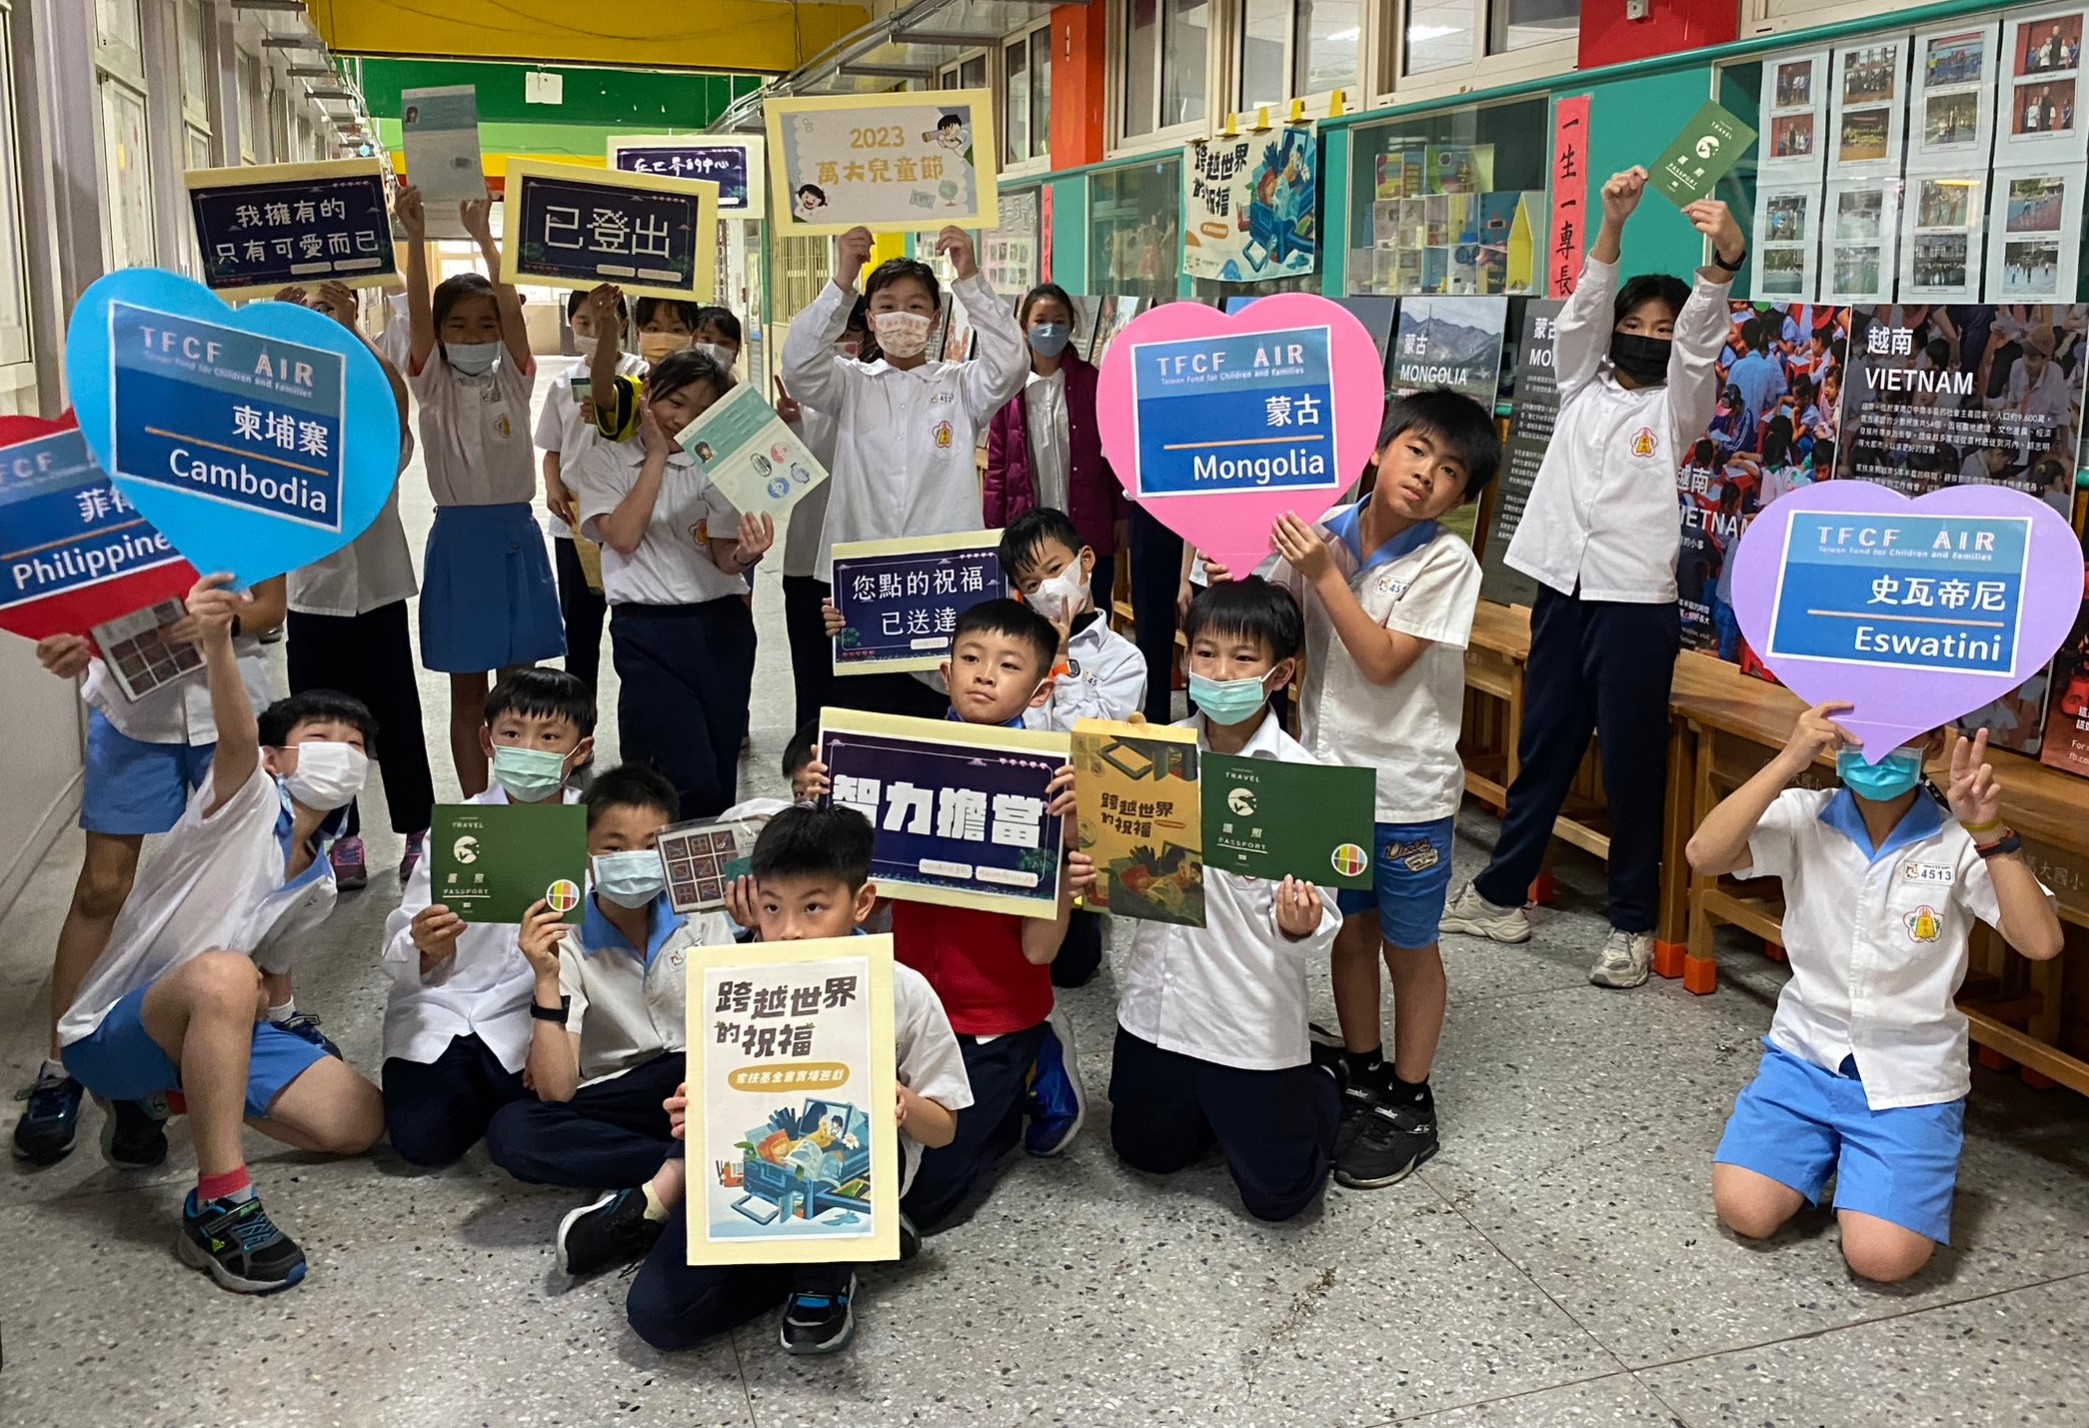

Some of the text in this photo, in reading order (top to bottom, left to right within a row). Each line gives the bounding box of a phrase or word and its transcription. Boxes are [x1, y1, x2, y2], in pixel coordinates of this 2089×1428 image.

[850, 126, 905, 148] 2023
[1710, 121, 1732, 140] TRAVEL
[816, 155, 944, 186] 萬大兒童節
[1195, 143, 1249, 180] 跨越世界
[1667, 162, 1698, 186] PASSPORT
[235, 197, 345, 228] 我擁有的
[1193, 177, 1230, 217] 的祝福
[1555, 118, 1579, 296] 一生一專長
[545, 205, 670, 258] 已登出
[216, 230, 379, 265] 只有可愛而已
[139, 325, 314, 387] TFCF AIR
[1404, 334, 1428, 354] 蒙古
[1868, 326, 1914, 356] 越南
[1156, 344, 1304, 376] TFCF AIR
[1186, 374, 1204, 383] Fund
[1207, 374, 1218, 382] for
[1220, 371, 1252, 381] Children
[1254, 369, 1269, 377] and
[1272, 367, 1304, 376] Families
[1400, 364, 1467, 386] MONGOLIA
[214, 366, 252, 383] Children
[255, 378, 273, 388] and
[275, 381, 312, 398] Families
[1865, 368, 1974, 395] VIETNAM
[1264, 393, 1321, 427] 蒙古
[232, 404, 330, 458] 柬埔寨
[170, 448, 327, 514] Cambodia
[1194, 450, 1324, 484] Mongolia
[1818, 526, 1995, 550] TFCF AIR
[1850, 547, 1870, 555] Fund
[1874, 548, 1887, 556] for
[1889, 548, 1928, 558] Children
[1932, 550, 1948, 559] and
[1952, 552, 1992, 561] Families
[852, 566, 984, 601] 您點的祝福
[1866, 574, 2006, 611] 史瓦帝尼
[881, 606, 957, 636] 已送達
[1854, 626, 2002, 662] Eswatini
[2072, 740, 2085, 750] For
[1226, 772, 1260, 784] TRAVEL
[832, 774, 1044, 848] 智力擔當
[1101, 792, 1174, 818] 跨越世界
[1100, 812, 1152, 838] 的祝福
[1218, 837, 1266, 850] PASSPORT
[1921, 869, 1952, 881] 4513
[442, 888, 490, 896] PASSPORT
[715, 976, 857, 1019] 跨越世界
[714, 1022, 814, 1058] 的祝福
